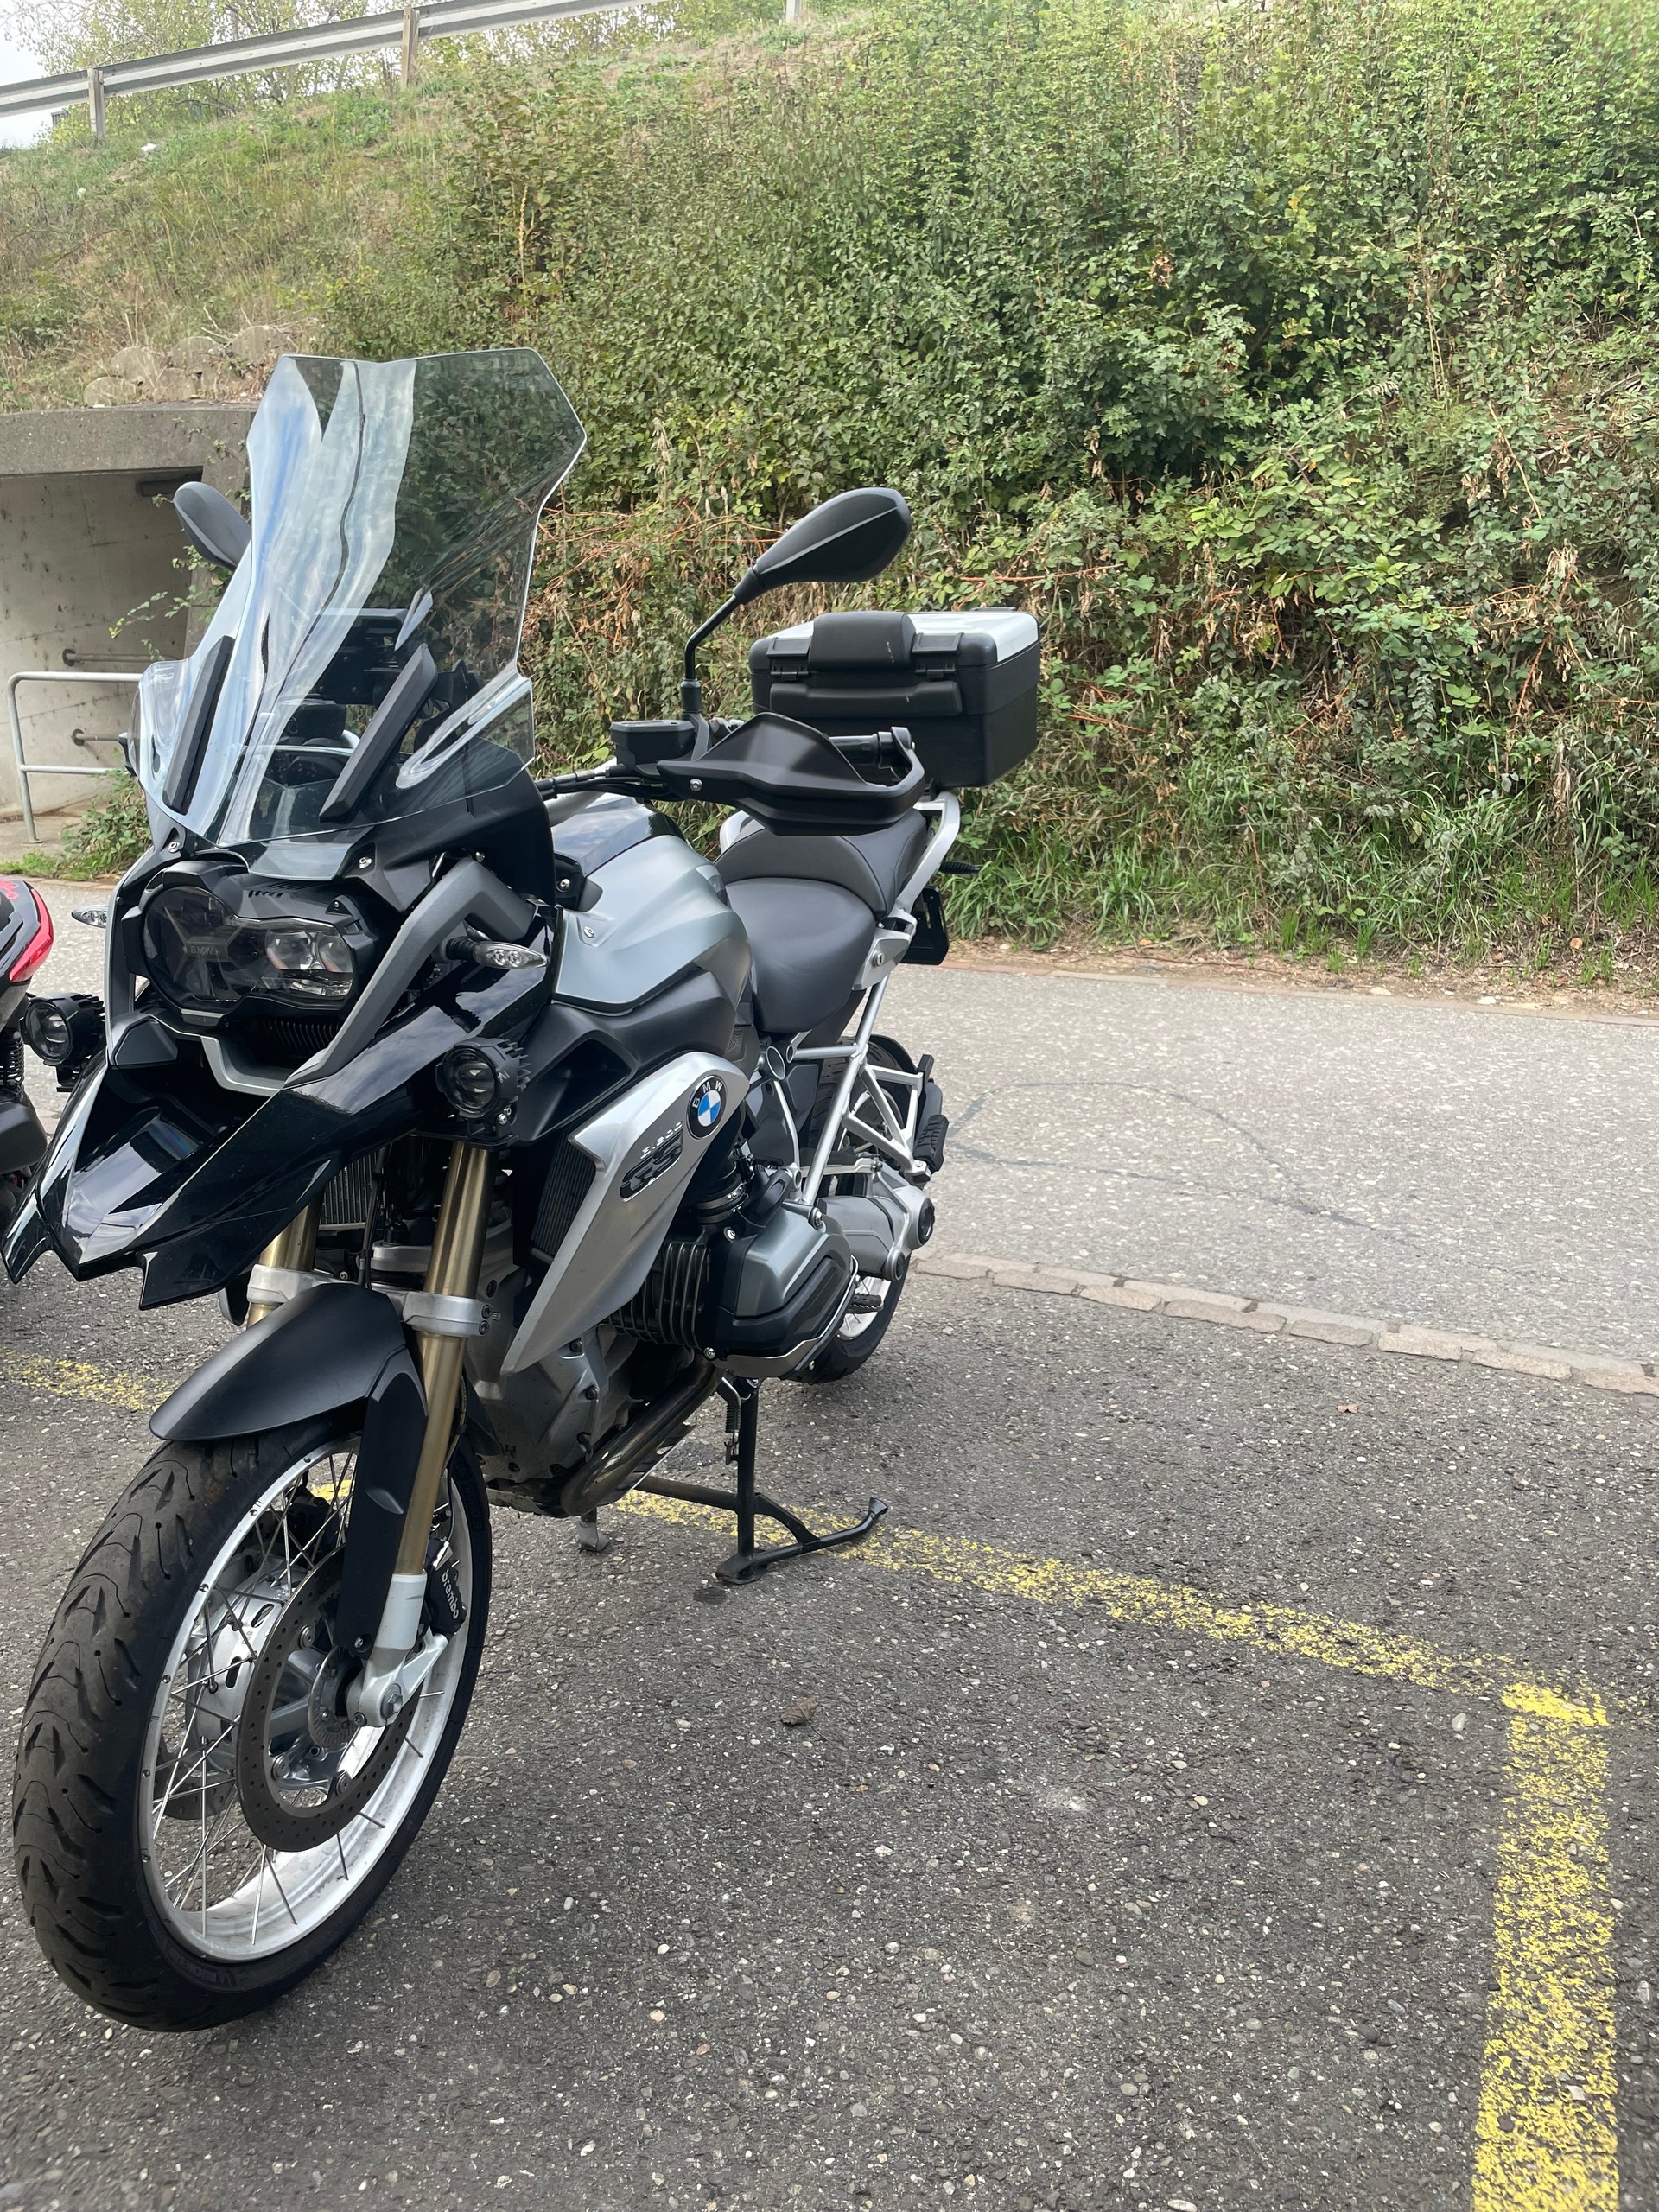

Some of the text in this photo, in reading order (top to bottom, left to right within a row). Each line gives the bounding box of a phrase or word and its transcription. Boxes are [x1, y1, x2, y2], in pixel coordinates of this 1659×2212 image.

[190, 945, 213, 955] BMW
[692, 1080, 722, 1108] BMW
[620, 1128, 683, 1202] GS
[441, 1568, 459, 1619] brembo
